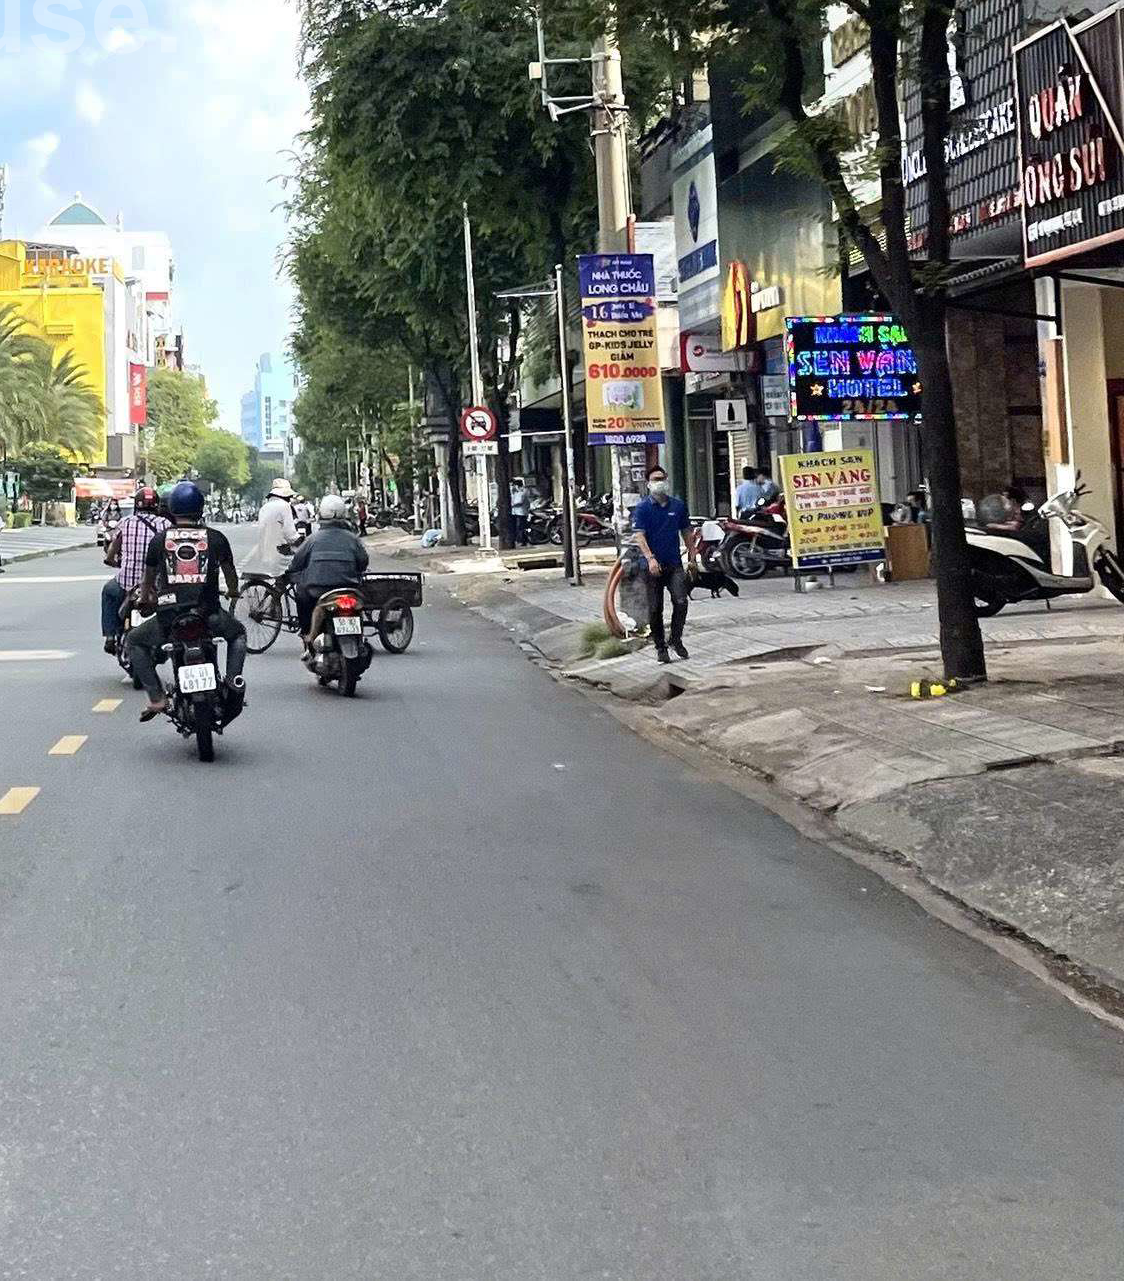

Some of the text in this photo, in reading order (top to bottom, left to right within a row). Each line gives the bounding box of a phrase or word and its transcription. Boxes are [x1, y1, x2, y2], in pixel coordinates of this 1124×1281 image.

[25, 255, 109, 274] KARAOKE
[588, 280, 649, 295] LONG CHÂU
[627, 340, 654, 349] JELLY
[855, 343, 918, 376] VÀN
[792, 473, 822, 489] SEN
[165, 529, 208, 539] BLOCK
[167, 574, 207, 584] PARTY
